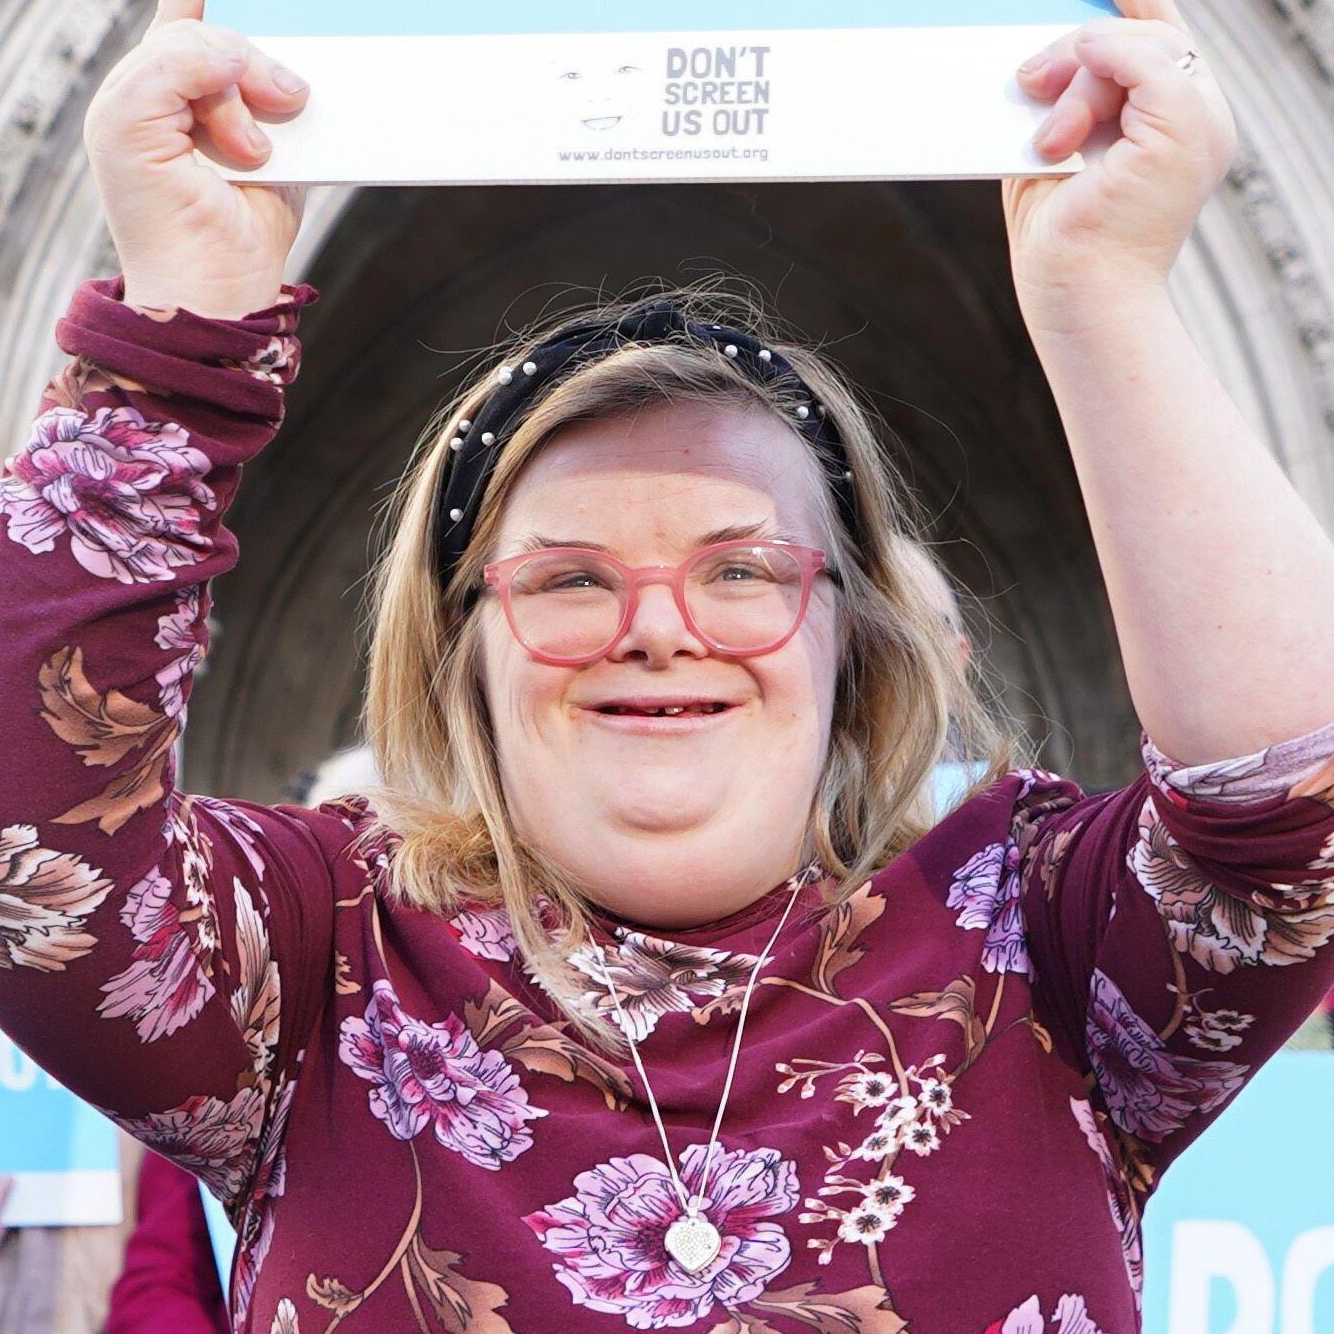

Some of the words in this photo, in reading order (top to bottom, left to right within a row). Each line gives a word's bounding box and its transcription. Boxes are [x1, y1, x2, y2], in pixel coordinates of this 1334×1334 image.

[666, 46, 770, 80] DON'T
[664, 81, 769, 106] SCREEN
[661, 110, 702, 137] US
[713, 108, 769, 135] OUT
[559, 146, 769, 162] www.dontscreenusout.org
